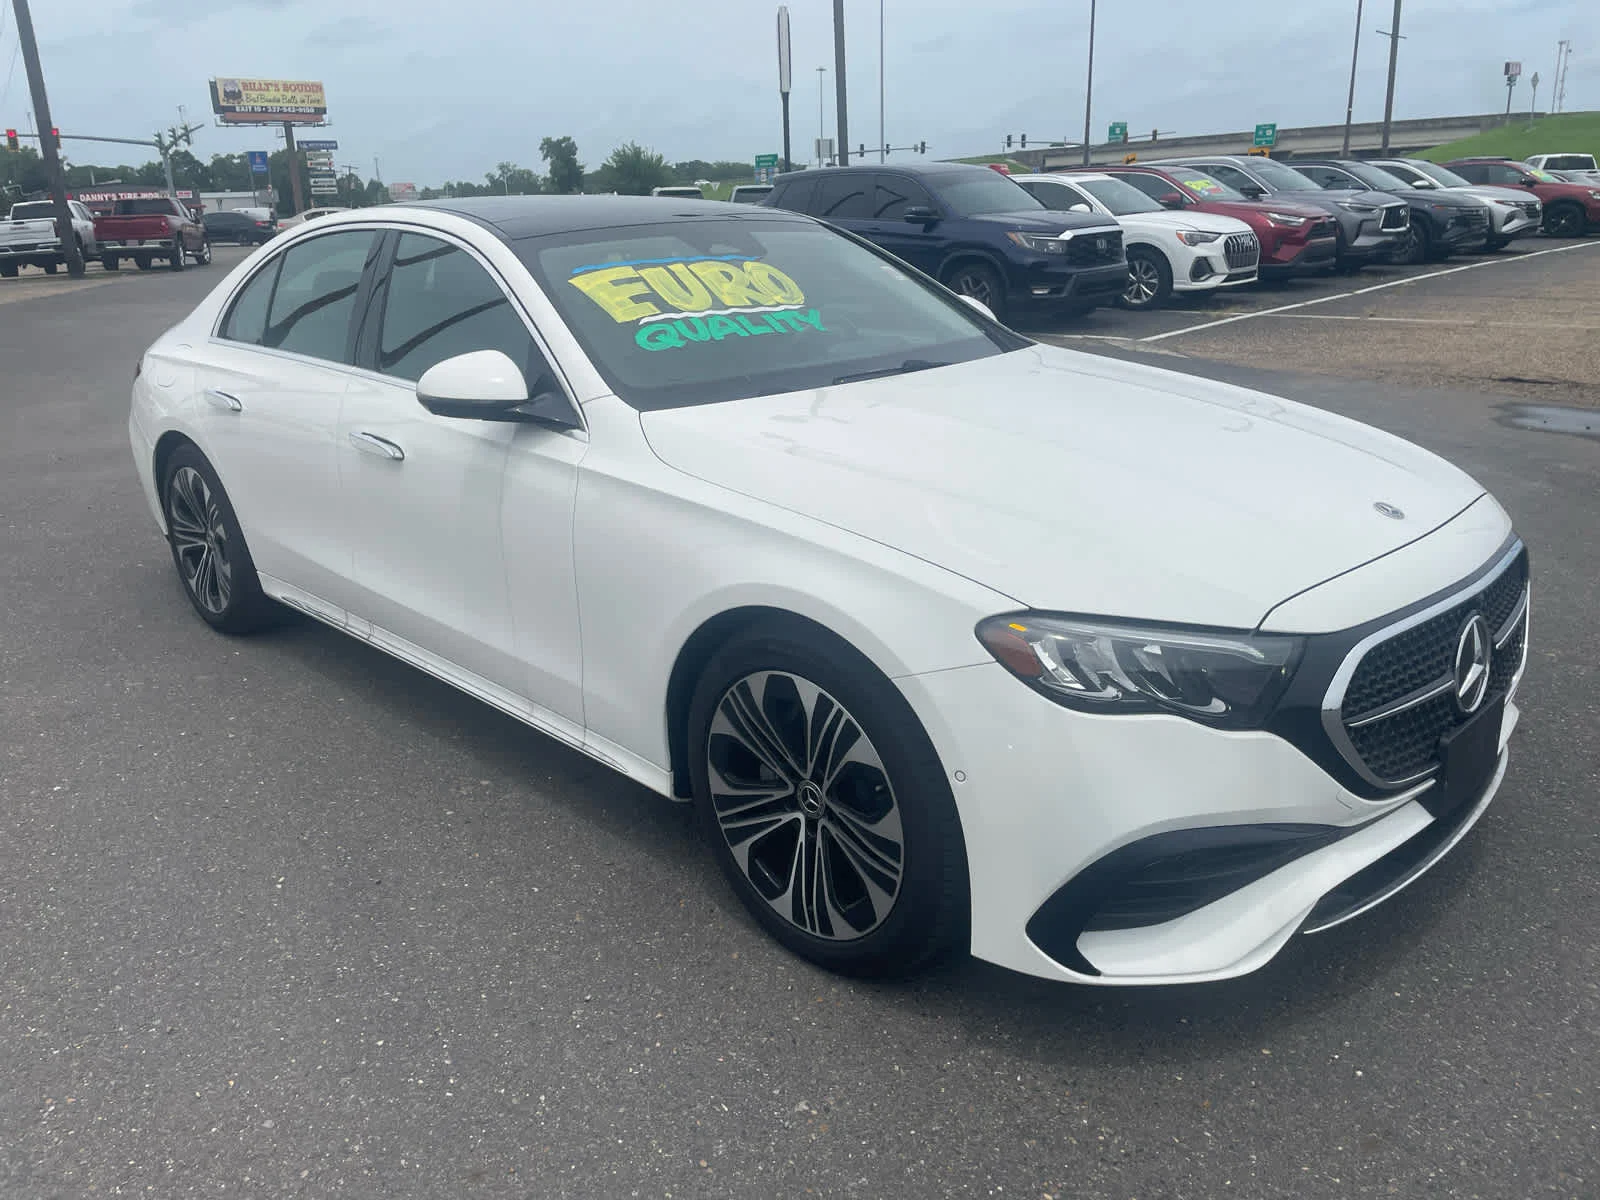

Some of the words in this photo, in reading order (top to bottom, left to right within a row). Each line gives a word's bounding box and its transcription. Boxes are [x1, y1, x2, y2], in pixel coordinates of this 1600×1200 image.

[241, 81, 280, 92] BILLY'S
[282, 82, 322, 93] BOUDIN
[80, 193, 117, 202] DANNY'S
[568, 261, 804, 323] EURO
[635, 308, 827, 351] QUALITY
